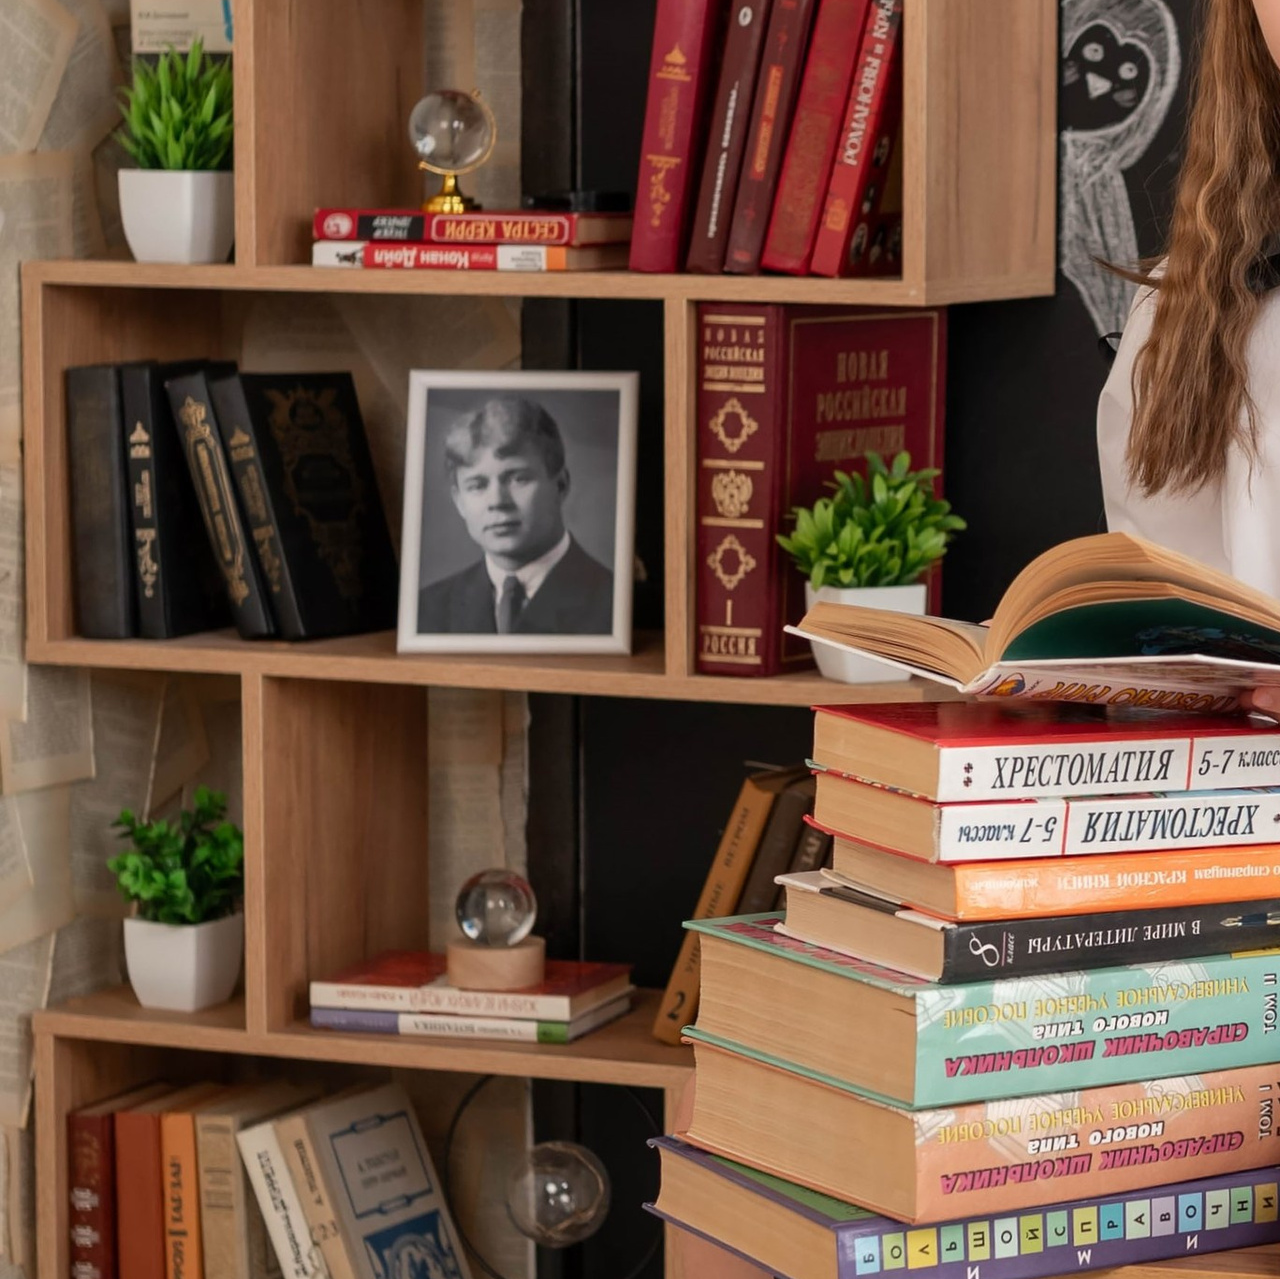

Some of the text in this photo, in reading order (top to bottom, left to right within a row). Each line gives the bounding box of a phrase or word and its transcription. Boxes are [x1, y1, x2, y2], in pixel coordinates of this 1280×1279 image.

[843, 56, 881, 167] РОМАНОВЫ
[444, 220, 560, 239] СЕСТРА КЕРРИ
[373, 248, 417, 269] Дойл
[420, 251, 470, 269] Конан
[704, 327, 765, 344] НОВАЯ
[704, 345, 765, 363] РОССИЙСКАЯ
[836, 349, 889, 383] НОВАЯ
[815, 384, 908, 423] РОССИЙСКАЯ
[703, 634, 757, 656] РОССИЯ
[991, 748, 1175, 790] ХРЕСТОМАТИЯ
[1197, 749, 1236, 776] 5-7
[957, 803, 1261, 844] ХРЕСТОМАТИЯ 5-7 классы
[1056, 872, 1110, 891] КНИГИ
[1117, 869, 1188, 888] КРАСНОЙ
[1193, 865, 1271, 881] страницам
[969, 932, 1016, 968] 8 класс
[1026, 919, 1202, 954] В МИРЕ ЛИТЕРАТУРЫ
[667, 990, 686, 1021] 2
[943, 976, 1251, 1029] УНИВЕРСАЛЬНОЕ УЧЕБНОЕ ПОСОБИЕ
[1264, 992, 1279, 1035] ТОМ
[944, 1022, 1250, 1079] СПРАВОЧНИК ШКОЛЬНИКА
[937, 1085, 1246, 1146] УНИВЕРСАЛЬНОЕ УЧЕБНОЕ ПОСОБИЕ
[1258, 1095, 1274, 1142] ТОМ
[940, 1130, 1245, 1196] СПРАВОЧНИК ШКОЛЬНИКА
